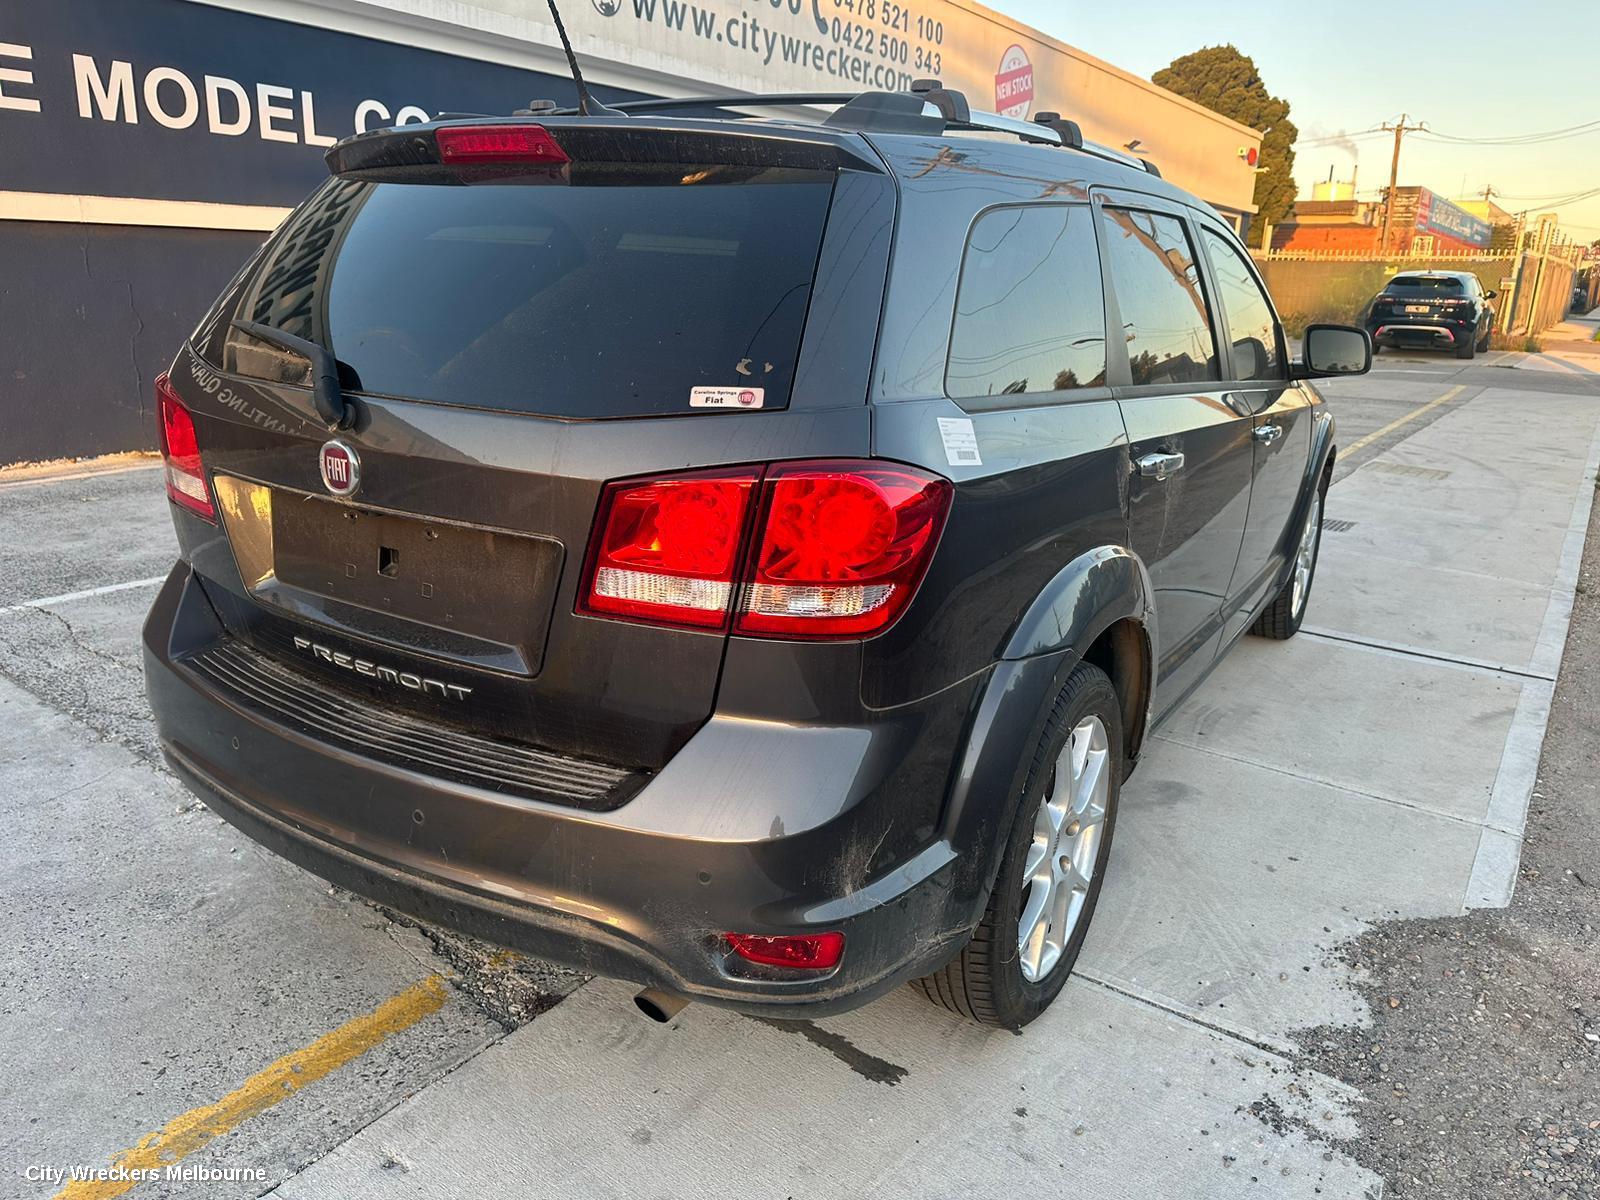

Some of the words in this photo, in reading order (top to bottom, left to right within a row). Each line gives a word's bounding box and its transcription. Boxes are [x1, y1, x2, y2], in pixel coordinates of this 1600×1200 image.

[835, 0, 875, 19] 478
[882, 1, 908, 32] 521
[918, 15, 943, 45] 100
[832, 17, 874, 54] 0422
[880, 33, 908, 65] 500
[915, 46, 941, 75] 343
[72, 53, 338, 148] MODEL
[997, 81, 1012, 99] NEW
[1012, 73, 1033, 95] STOCK
[705, 396, 724, 404] Fiat
[326, 455, 348, 482] FIAT
[293, 635, 472, 701] FREEMONT
